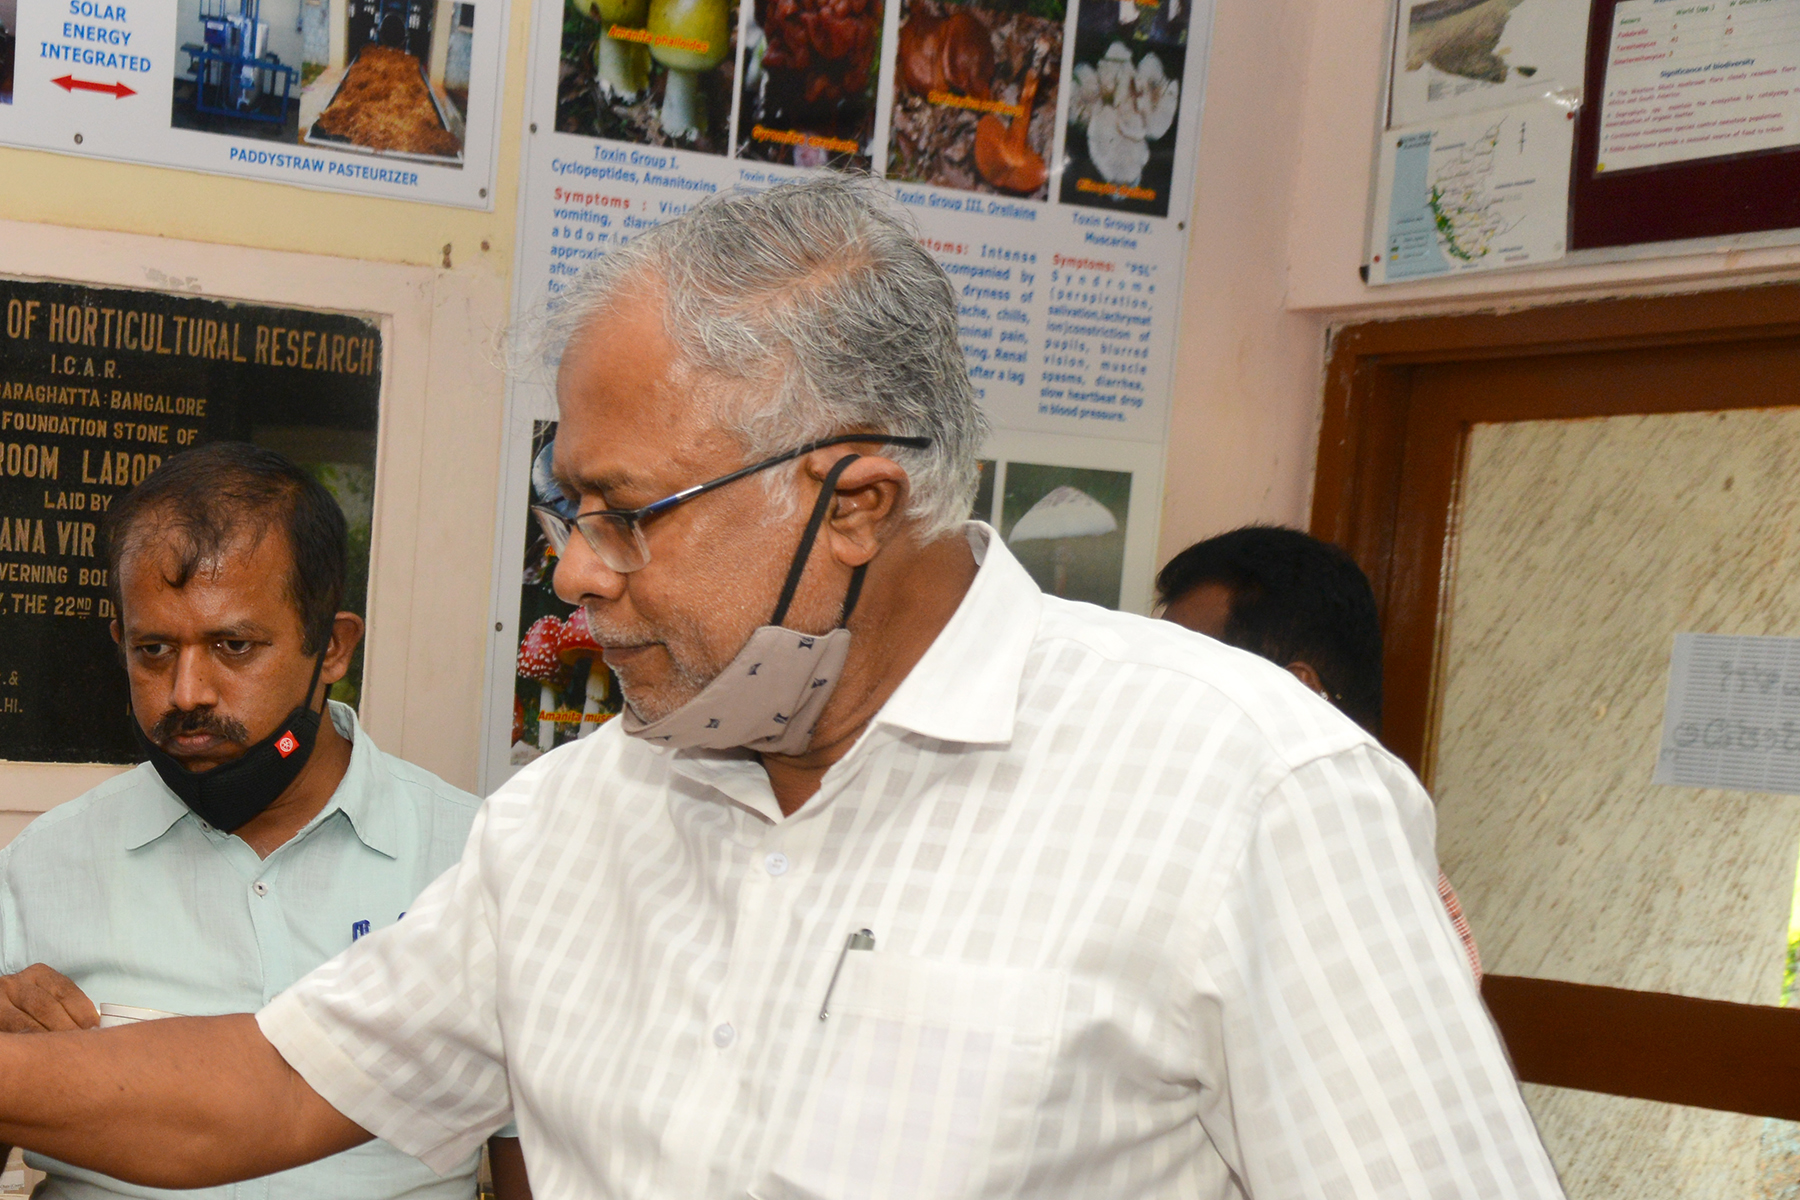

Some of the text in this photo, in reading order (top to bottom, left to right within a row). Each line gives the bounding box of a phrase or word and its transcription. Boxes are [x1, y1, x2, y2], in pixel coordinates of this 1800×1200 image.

[70, 0, 127, 22] SOLAR
[63, 22, 132, 46] ENERGY
[40, 42, 152, 73] INTEGRATED
[230, 147, 418, 187] PADDYSTRAW PASTEURIZER
[594, 145, 627, 162] Toxin
[630, 151, 667, 170] Group
[551, 158, 640, 185] Cyclopeptides,
[643, 172, 718, 193] Amanitoxins
[895, 188, 925, 207] Toxin
[928, 193, 962, 212] Group
[552, 207, 612, 227] vomiting,
[1072, 212, 1100, 227] Toxin
[1103, 216, 1135, 234] Group
[6, 299, 40, 340] OF
[49, 303, 247, 363] HORTICULTURAL
[254, 324, 375, 376] RESEARCH
[50, 353, 122, 379] I.C.A.R.
[110, 390, 208, 417] BANGALORE
[2, 410, 107, 438] FOUNDATION
[113, 422, 168, 444] STONE
[176, 428, 198, 446] OF
[43, 490, 112, 512] LAID BY
[56, 520, 96, 558] VIR
[11, 592, 48, 615] THE
